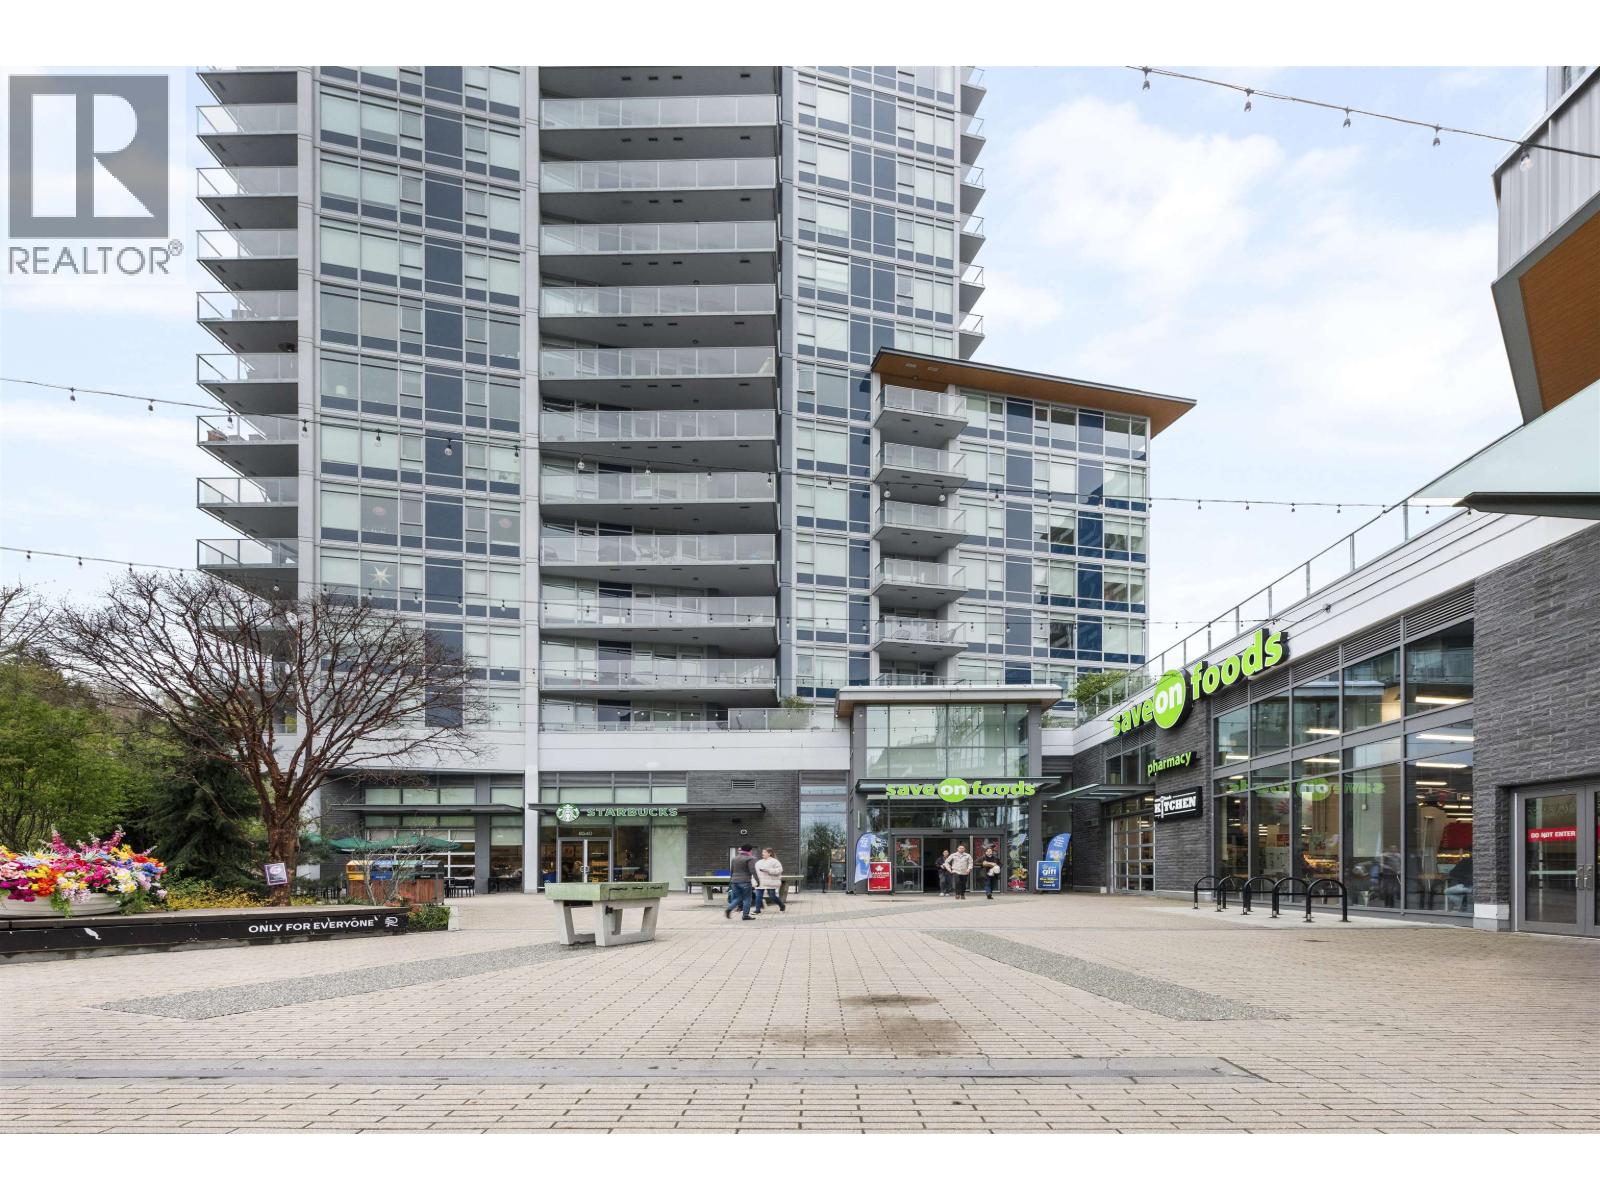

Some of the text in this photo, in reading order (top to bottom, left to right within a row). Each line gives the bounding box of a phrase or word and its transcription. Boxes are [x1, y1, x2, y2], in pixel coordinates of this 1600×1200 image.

[1112, 628, 1283, 737] save on foods
[1147, 751, 1192, 777] pharmacy
[886, 780, 1036, 796] save on foods
[586, 807, 678, 817] STARBUCKS
[1154, 796, 1197, 816] KITCHEN
[248, 923, 283, 933] ONLY
[286, 922, 311, 931] FOR
[313, 919, 375, 930] EVERYONE
